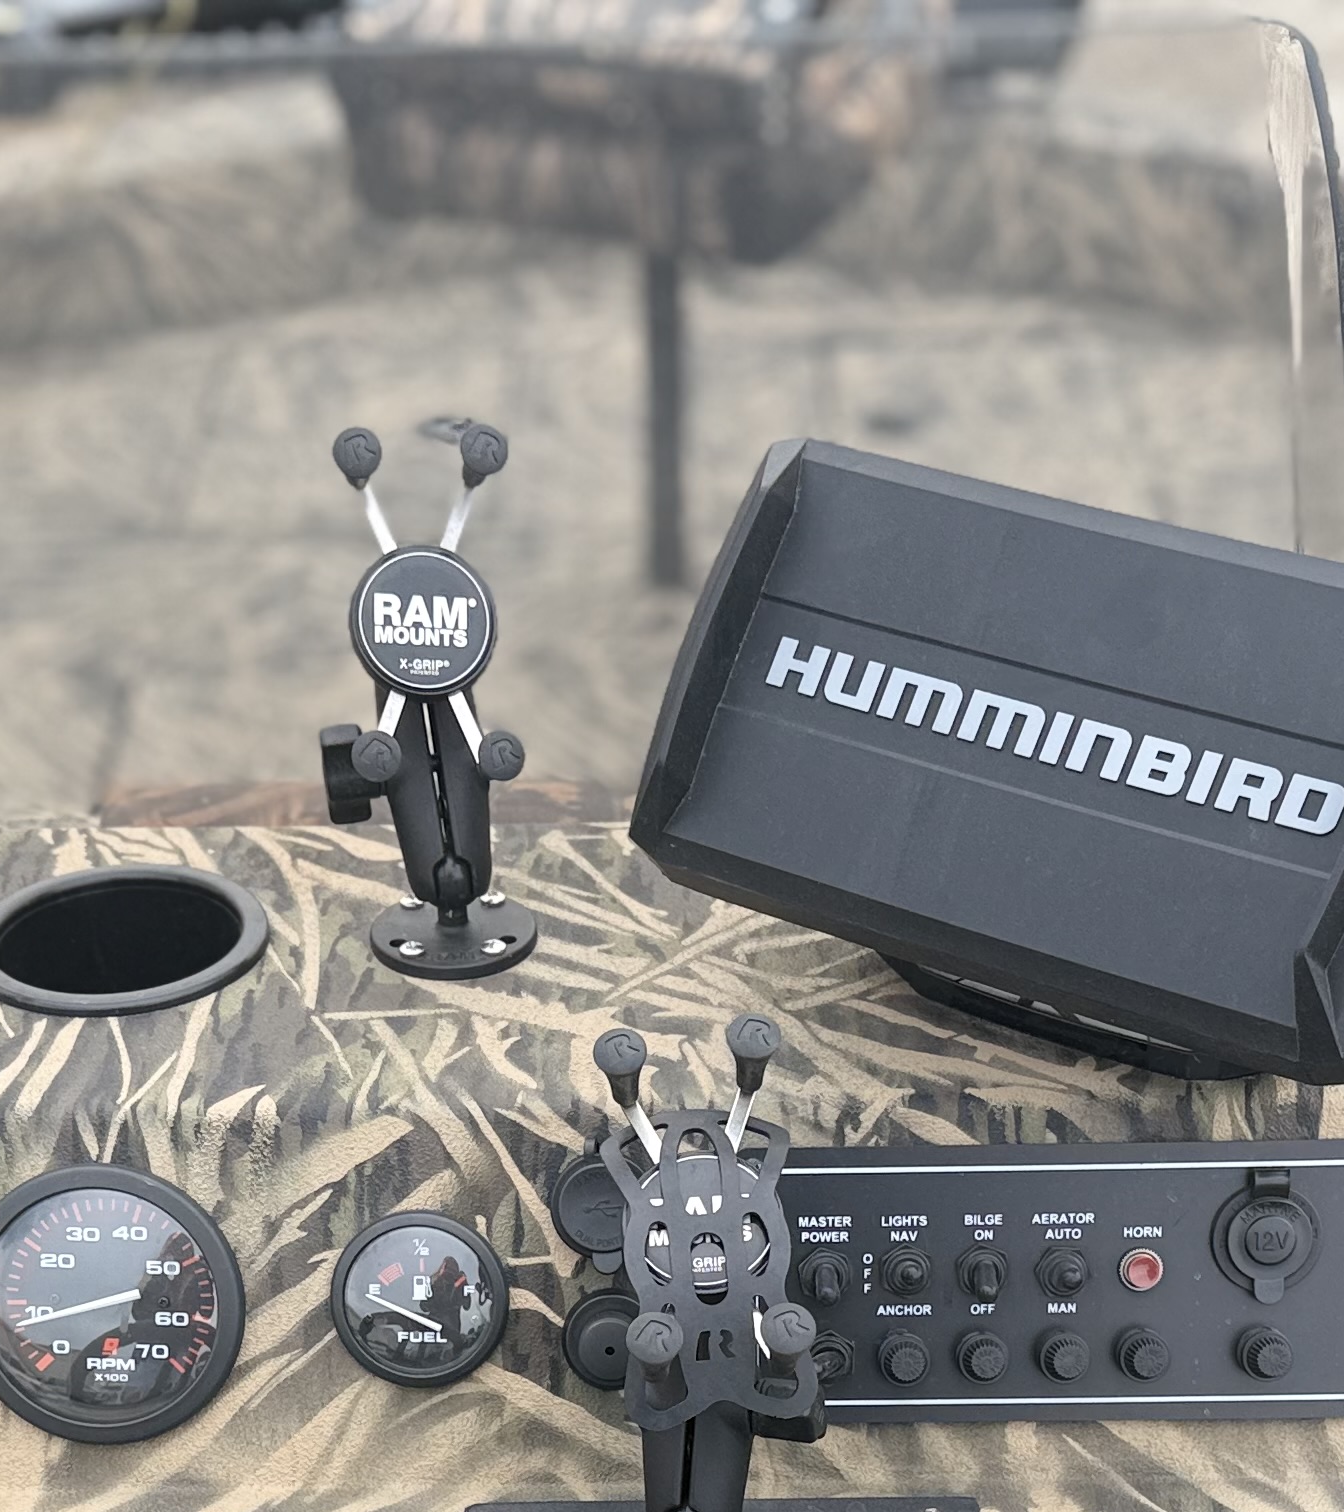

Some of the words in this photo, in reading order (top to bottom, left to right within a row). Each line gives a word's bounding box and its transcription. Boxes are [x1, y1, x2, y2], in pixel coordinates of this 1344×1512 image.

[374, 625, 468, 648] MOUNTS
[798, 1216, 853, 1228] MASTER
[881, 1215, 928, 1227] LIGHTS
[964, 1214, 1003, 1226] BILGE
[1031, 1213, 1095, 1225] AERATOR
[65, 1227, 101, 1242] 30
[112, 1226, 148, 1241] 40
[801, 1231, 850, 1243] POWER
[890, 1230, 918, 1242] NAV
[974, 1229, 994, 1241] ON
[1045, 1228, 1082, 1240] AUTO
[1123, 1226, 1163, 1238] HORN
[1254, 1230, 1289, 1252] 12V
[40, 1253, 76, 1269] 20
[146, 1260, 181, 1276] 50
[368, 1284, 381, 1295] E
[463, 1285, 476, 1297] F
[24, 1305, 54, 1320] 10
[876, 1304, 933, 1316] ANCHOR
[970, 1303, 996, 1315] OFF
[1047, 1302, 1077, 1314] MAN
[154, 1311, 190, 1327] 60
[397, 1331, 448, 1343] FUEL
[52, 1340, 71, 1355] 0
[135, 1344, 170, 1360] 70
[86, 1358, 136, 1371] RPM
